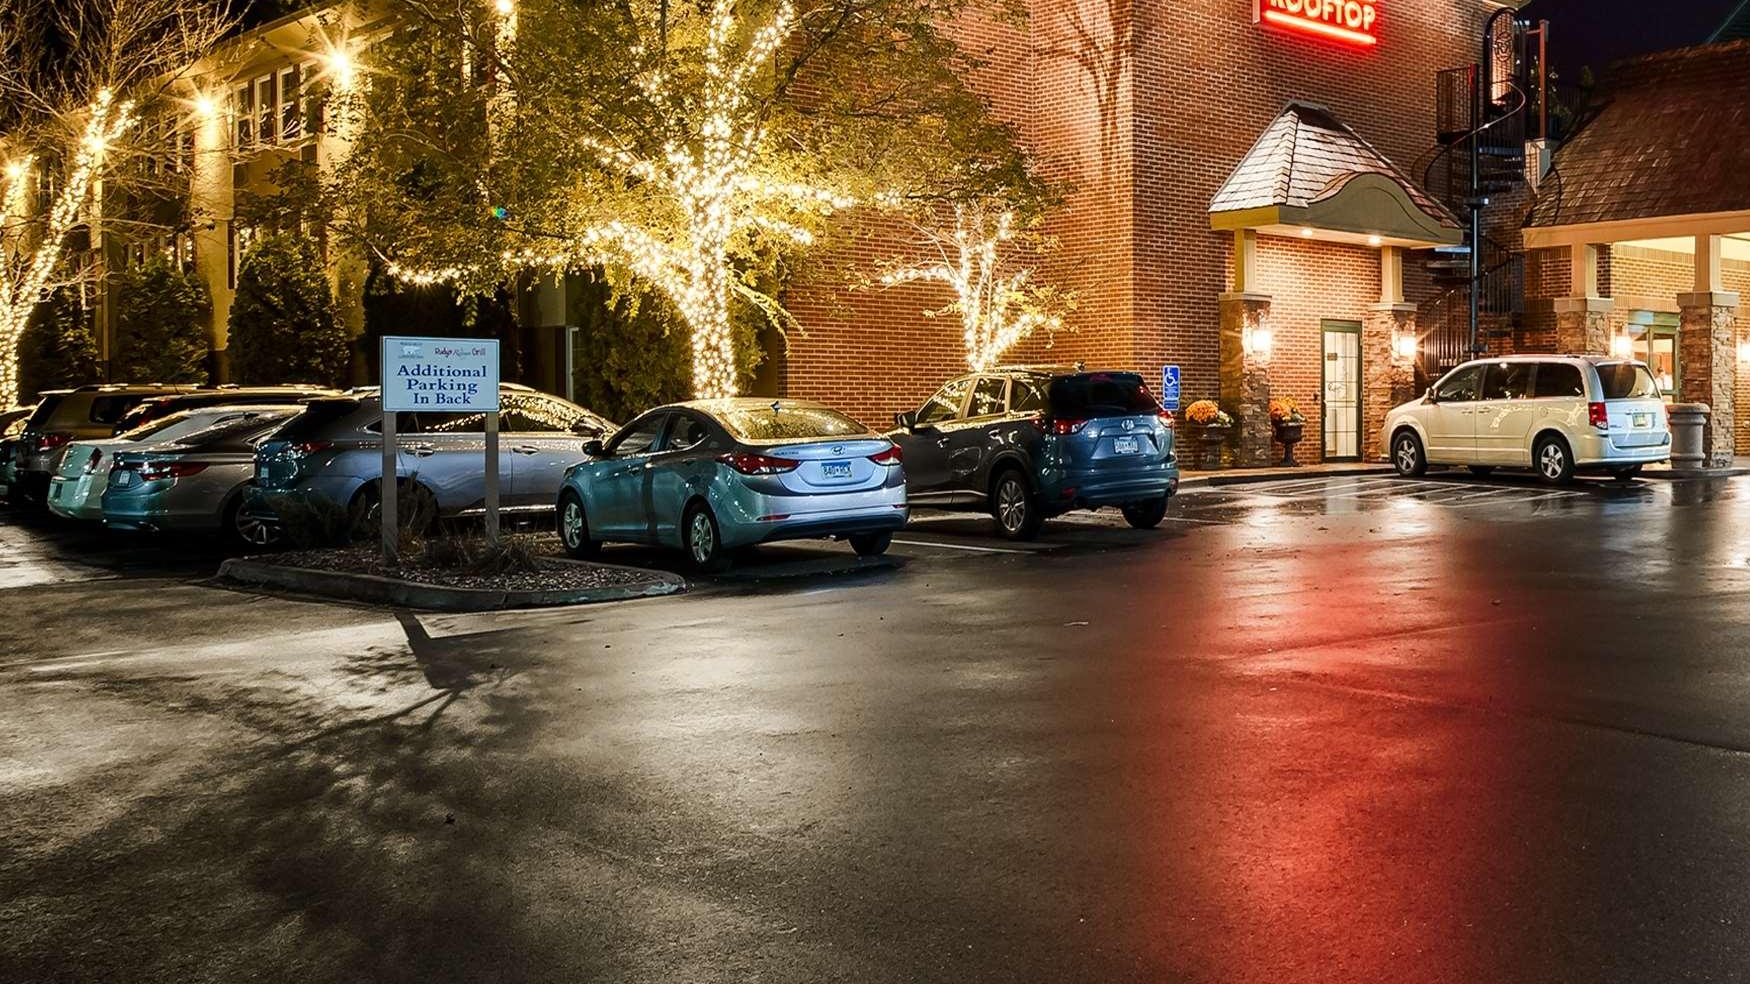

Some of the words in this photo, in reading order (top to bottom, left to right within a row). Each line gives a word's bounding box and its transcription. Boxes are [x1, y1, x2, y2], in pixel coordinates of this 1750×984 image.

[397, 363, 487, 377] Additional
[406, 378, 478, 395] Parking
[413, 392, 430, 405] In
[436, 393, 471, 405] Back
